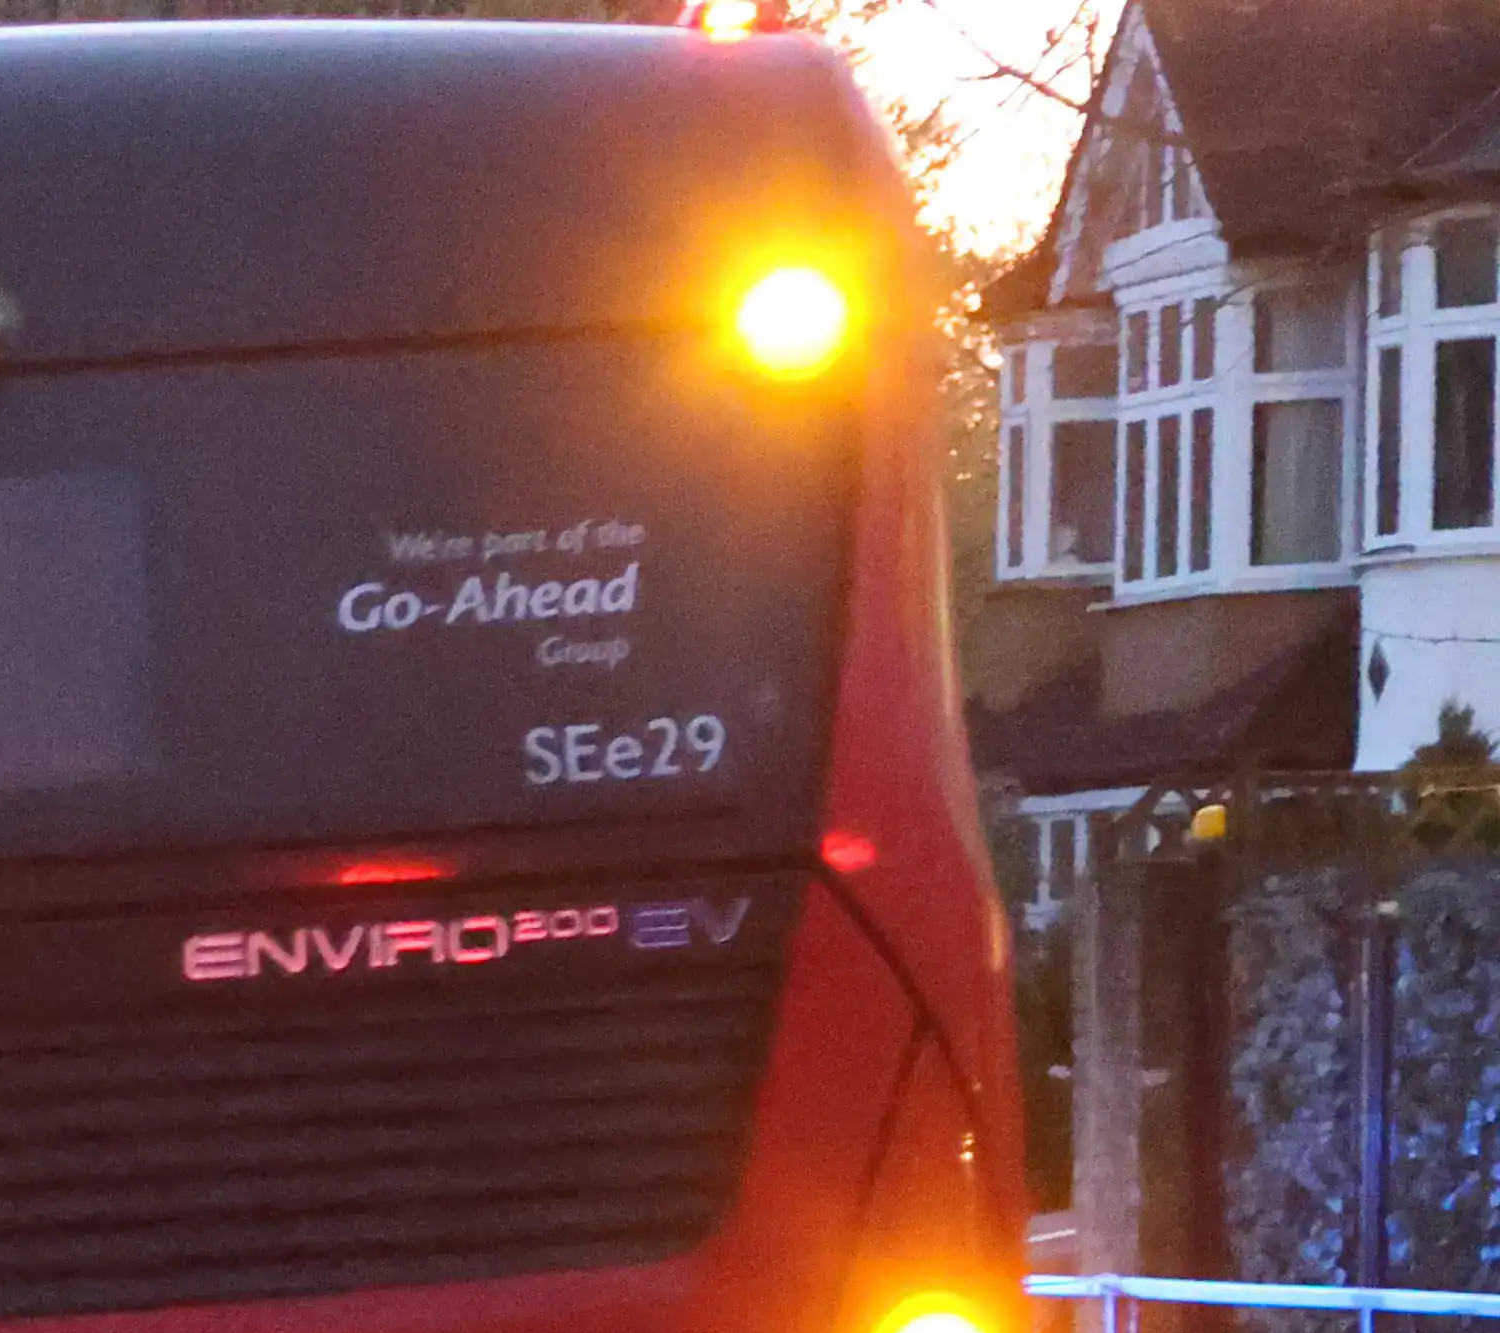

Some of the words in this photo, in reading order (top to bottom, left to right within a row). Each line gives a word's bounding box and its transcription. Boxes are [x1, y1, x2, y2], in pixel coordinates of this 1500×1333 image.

[557, 522, 593, 552] of
[337, 563, 639, 633] Go-Ahead
[537, 634, 630, 670] Group
[524, 714, 726, 785] SEe29
